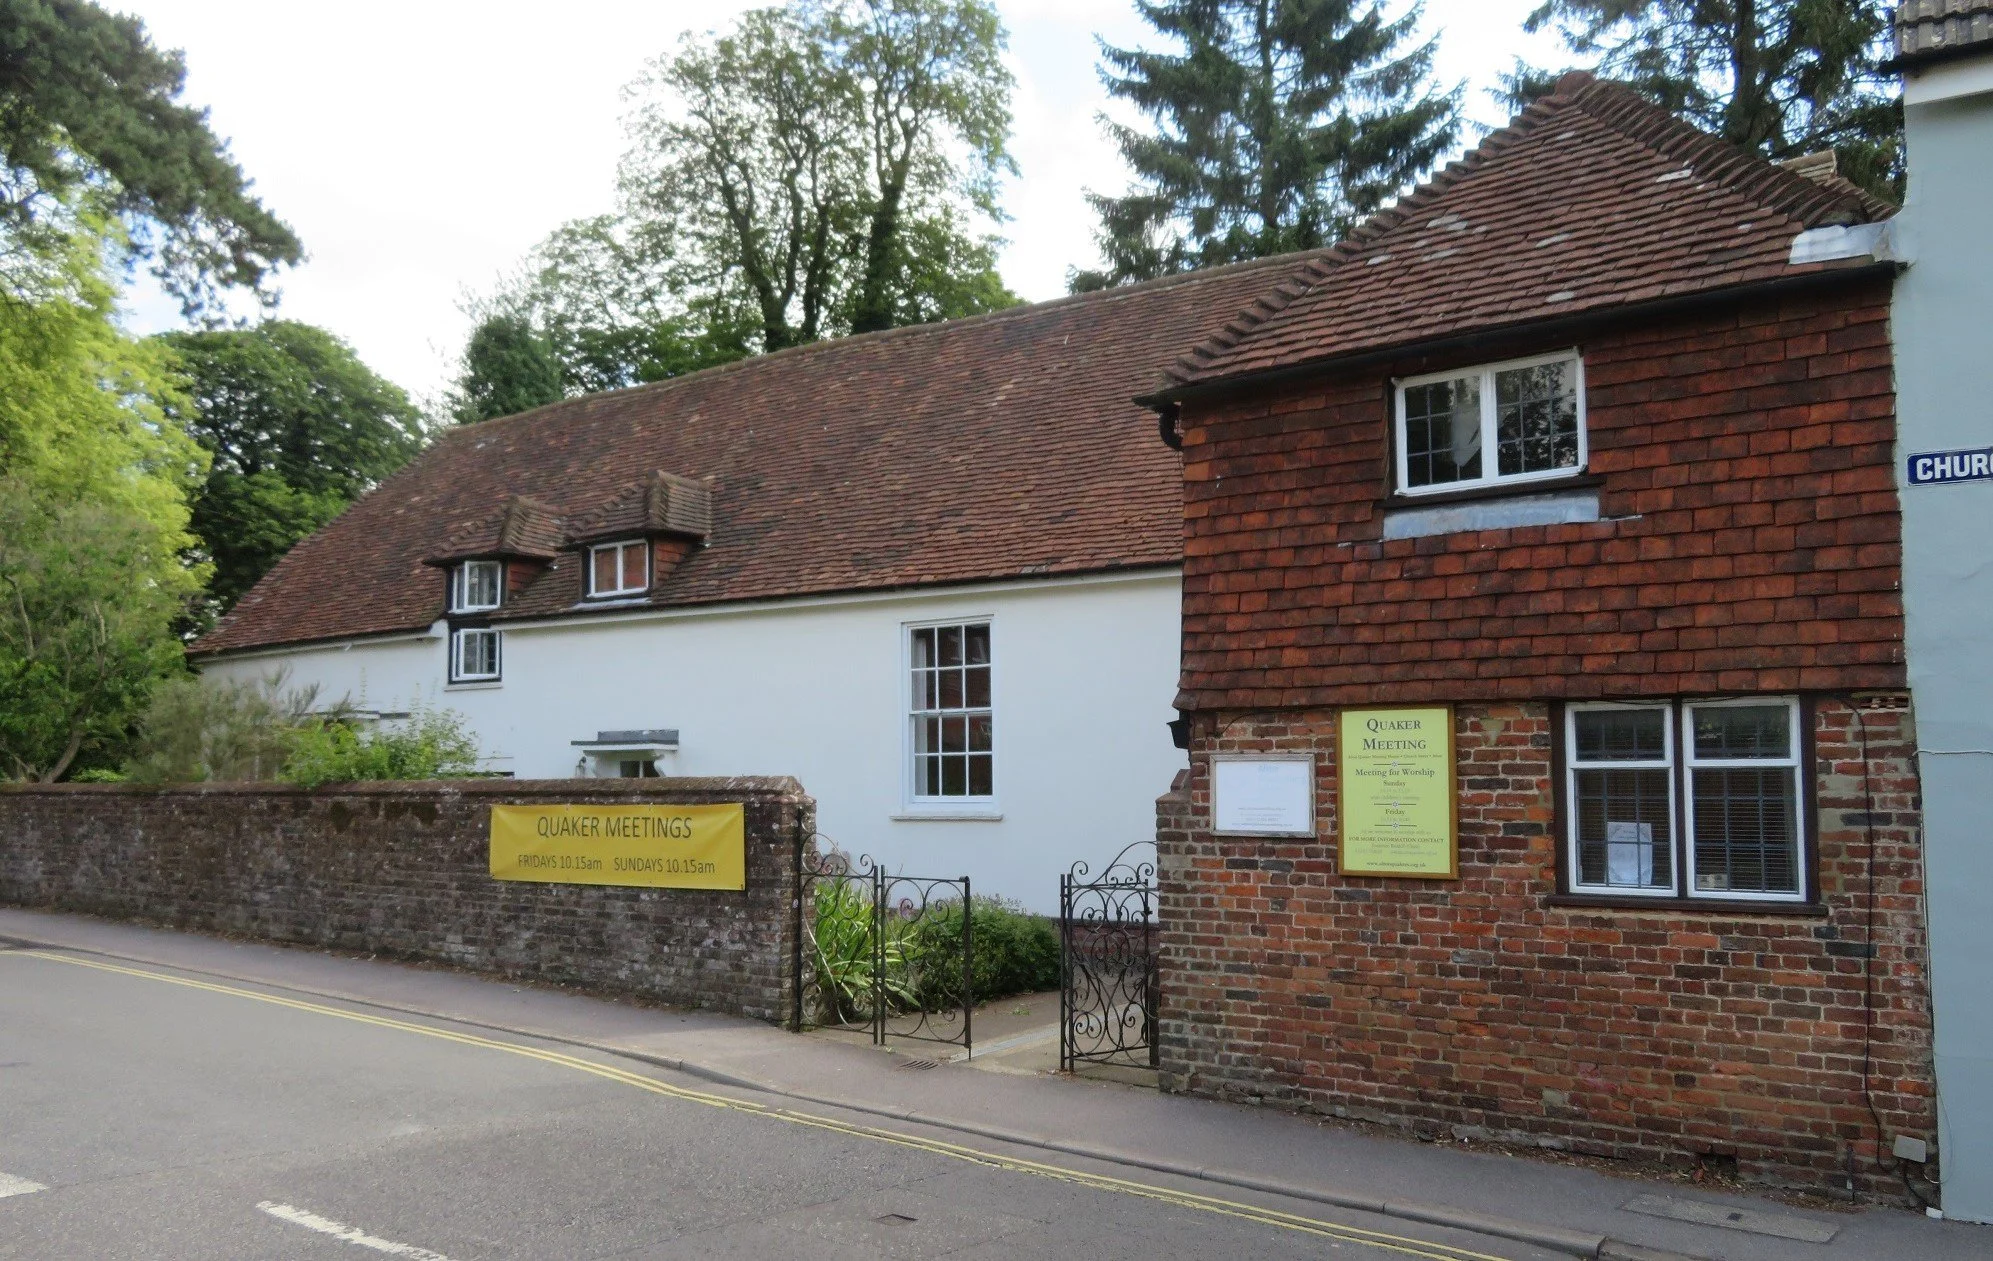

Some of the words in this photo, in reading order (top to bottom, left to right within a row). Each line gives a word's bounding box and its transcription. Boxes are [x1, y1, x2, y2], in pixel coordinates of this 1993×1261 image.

[1916, 453, 1993, 480] CHUR
[1366, 718, 1422, 733] QUAKER
[1363, 738, 1427, 750] MEETING
[1355, 768, 1387, 777] Meeting
[1389, 768, 1400, 776] for
[1402, 768, 1435, 777] Worship
[537, 816, 600, 837] QUAKER
[605, 817, 692, 838] MEETINGS
[518, 855, 556, 869] FRIDAYS
[560, 855, 602, 870] 10.15am
[614, 857, 664, 872] SUNDAYS
[666, 859, 715, 874] 10.15am
